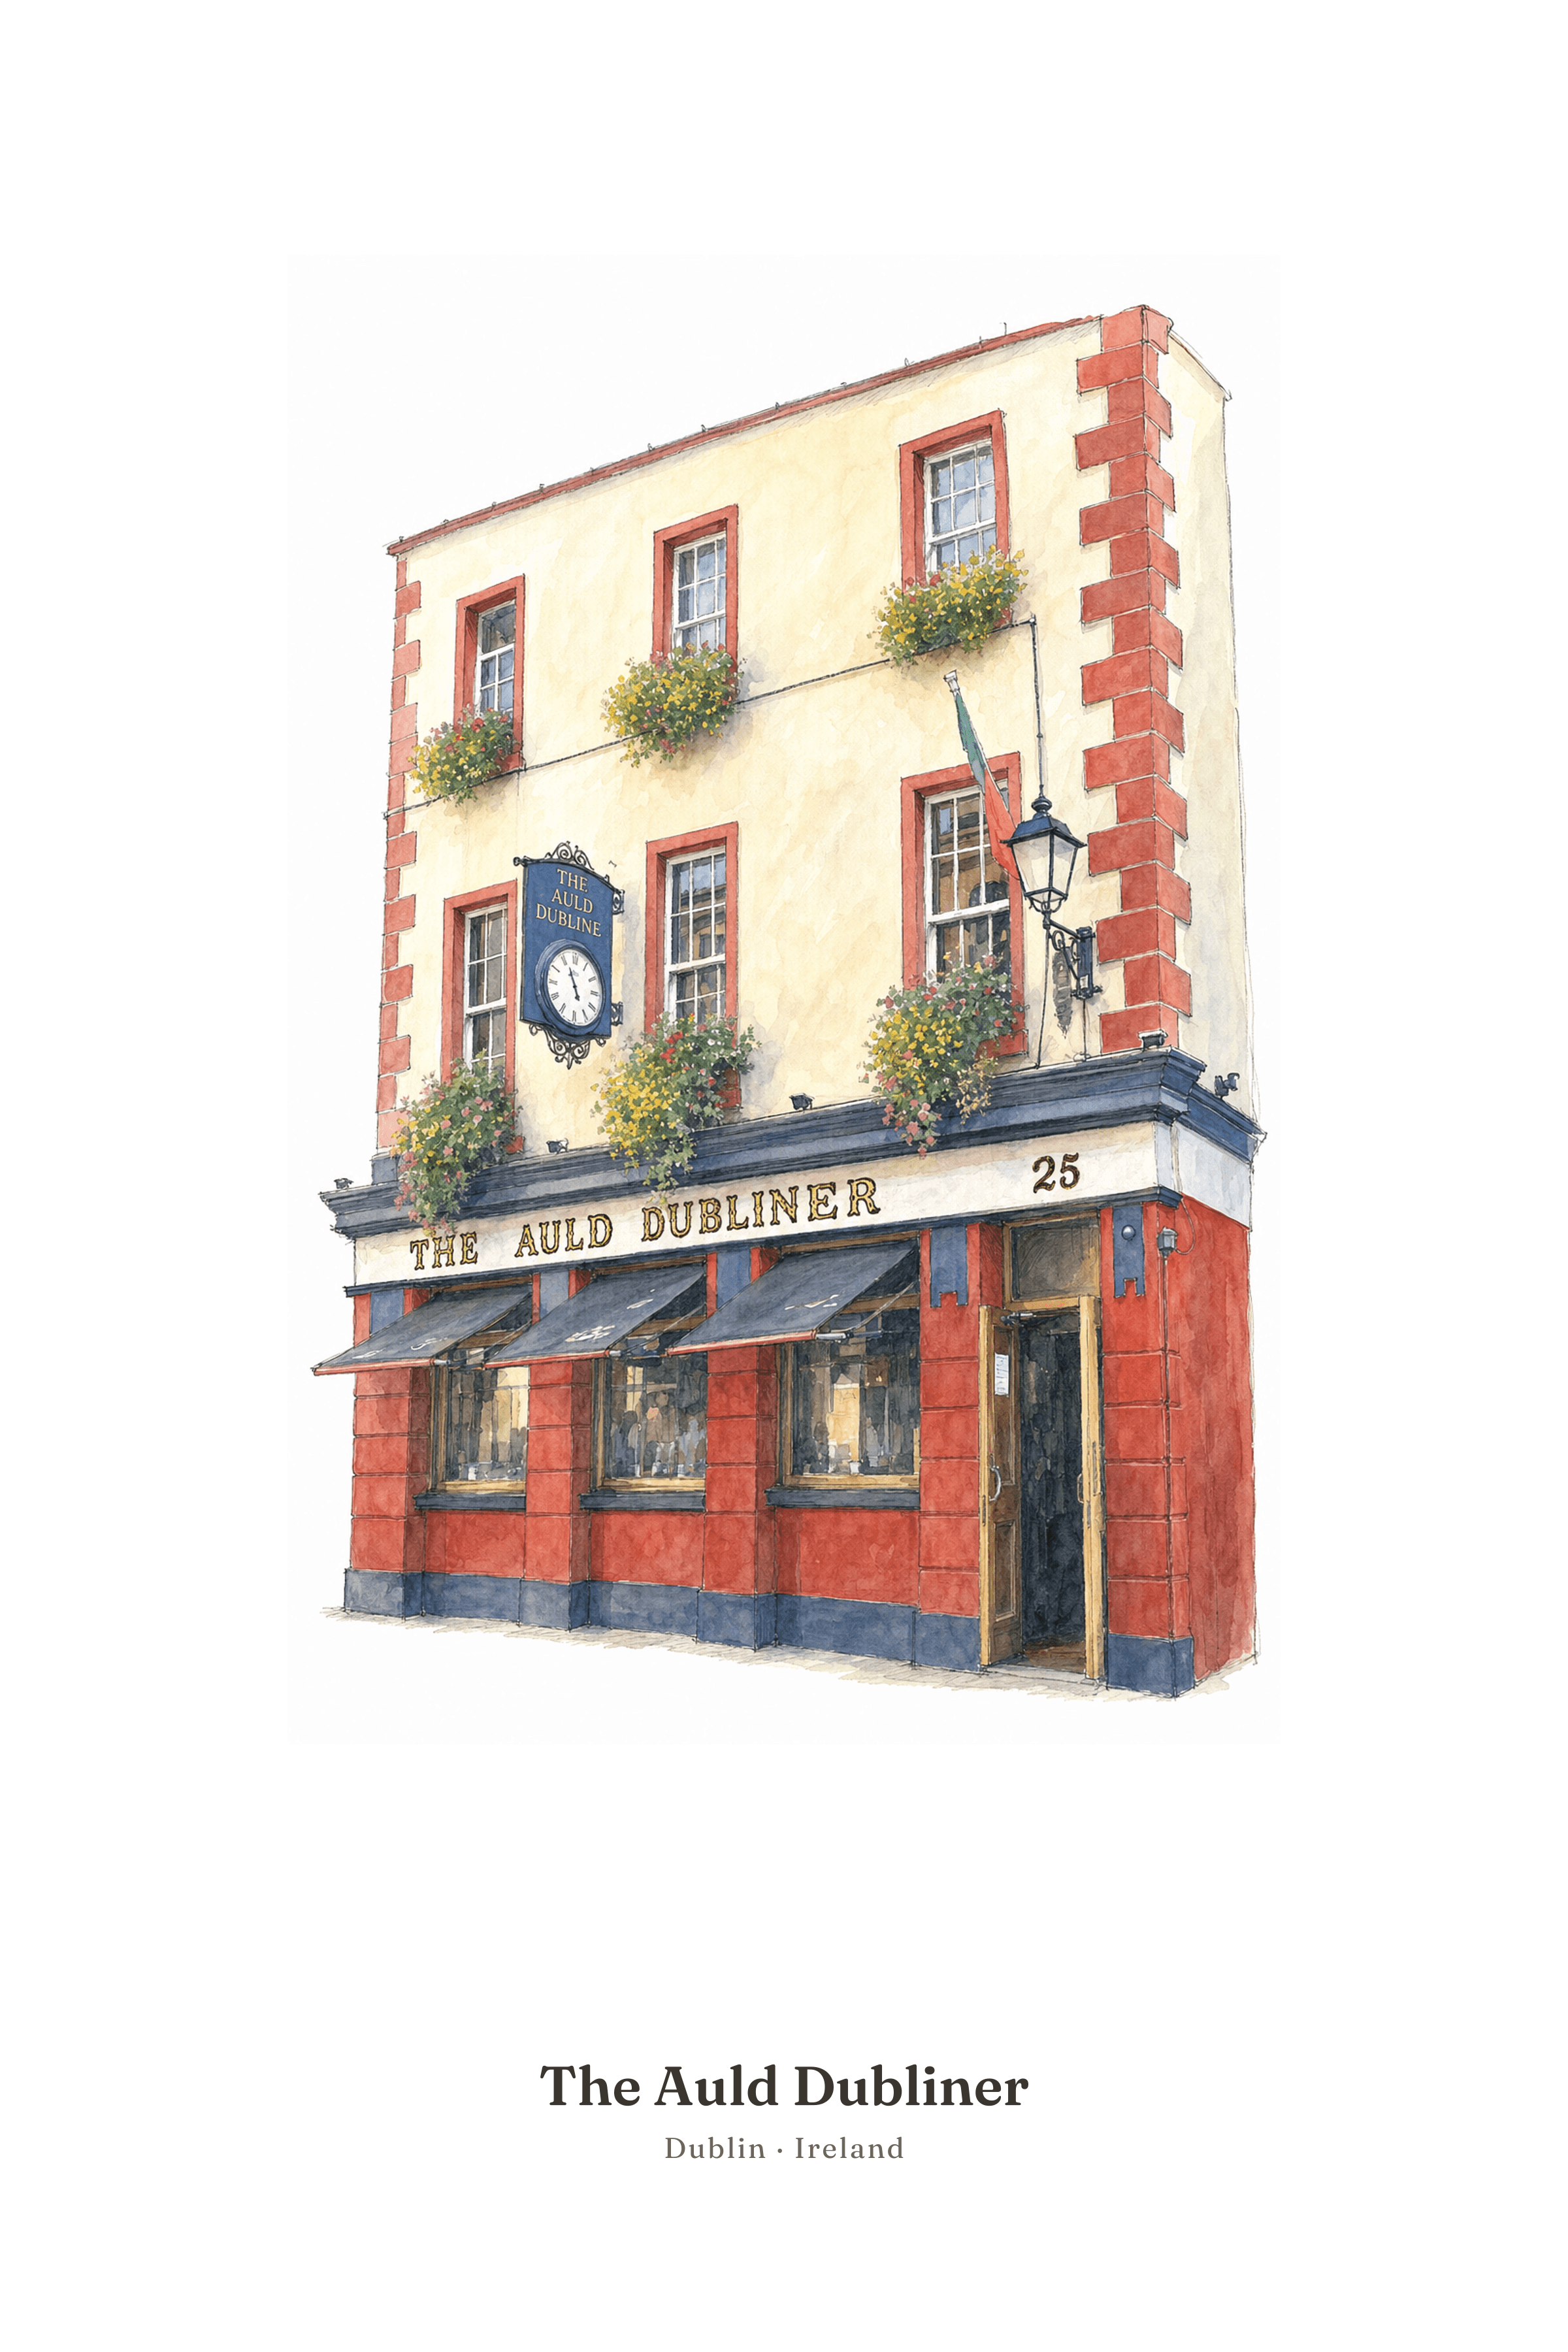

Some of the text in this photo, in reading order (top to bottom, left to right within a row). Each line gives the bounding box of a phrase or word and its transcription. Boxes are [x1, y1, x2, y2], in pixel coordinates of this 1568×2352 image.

[557, 868, 588, 893] THE
[551, 889, 593, 913] AULD
[536, 903, 601, 937] DUBLINE
[1032, 1152, 1081, 1194] 25
[410, 1176, 883, 1271] THE AULD DUBLINER
